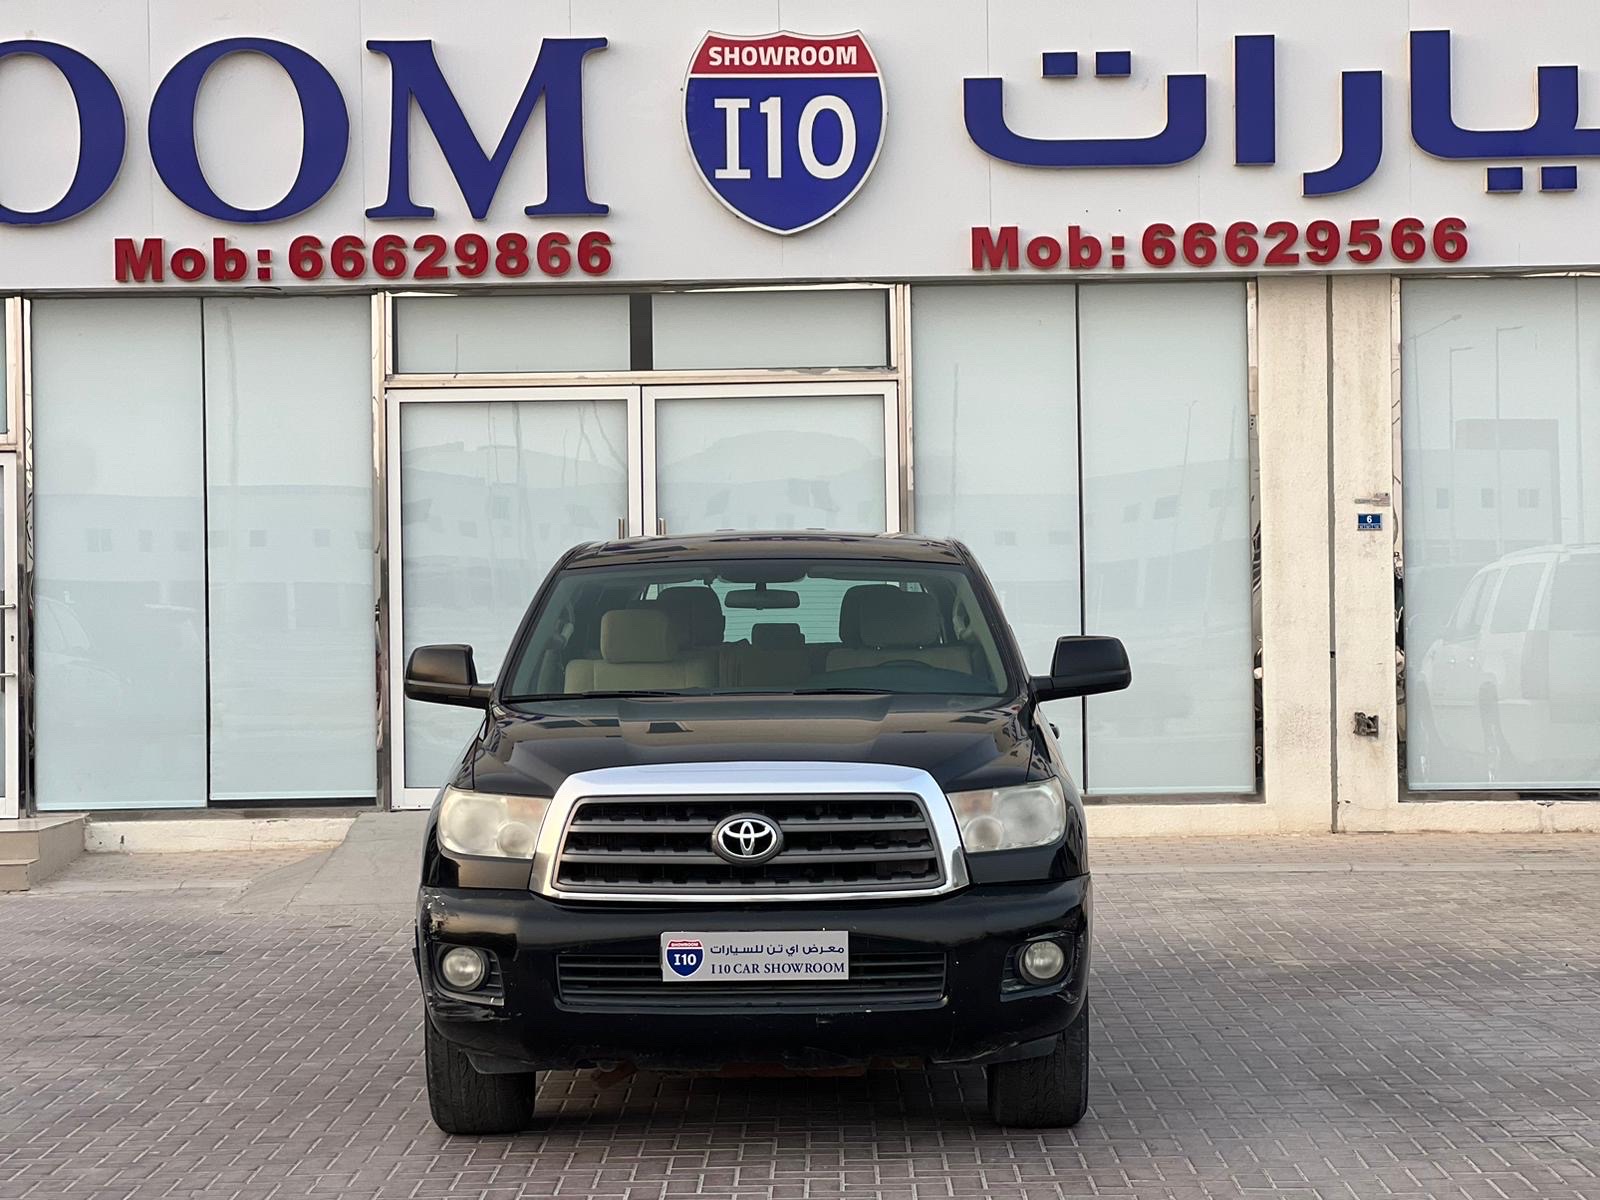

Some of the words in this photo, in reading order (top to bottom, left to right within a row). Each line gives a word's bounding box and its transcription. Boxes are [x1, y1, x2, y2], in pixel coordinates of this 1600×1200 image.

[708, 45, 857, 66] SHOWROOM
[963, 29, 1600, 198] يارات
[0, 37, 610, 226] OOM
[714, 95, 857, 180] I10
[971, 225, 1126, 270] Mob:
[1141, 217, 1469, 266] 66629566
[114, 237, 273, 282] Mob:
[288, 231, 613, 280] 66629866
[1366, 515, 1373, 524] 6
[710, 944, 764, 956] للسيارات
[766, 944, 784, 955] تن
[785, 944, 799, 957] اي
[802, 943, 845, 955] معرض
[673, 953, 698, 966] I10
[733, 963, 760, 974] CAR
[763, 962, 845, 974] SHOWROOM
